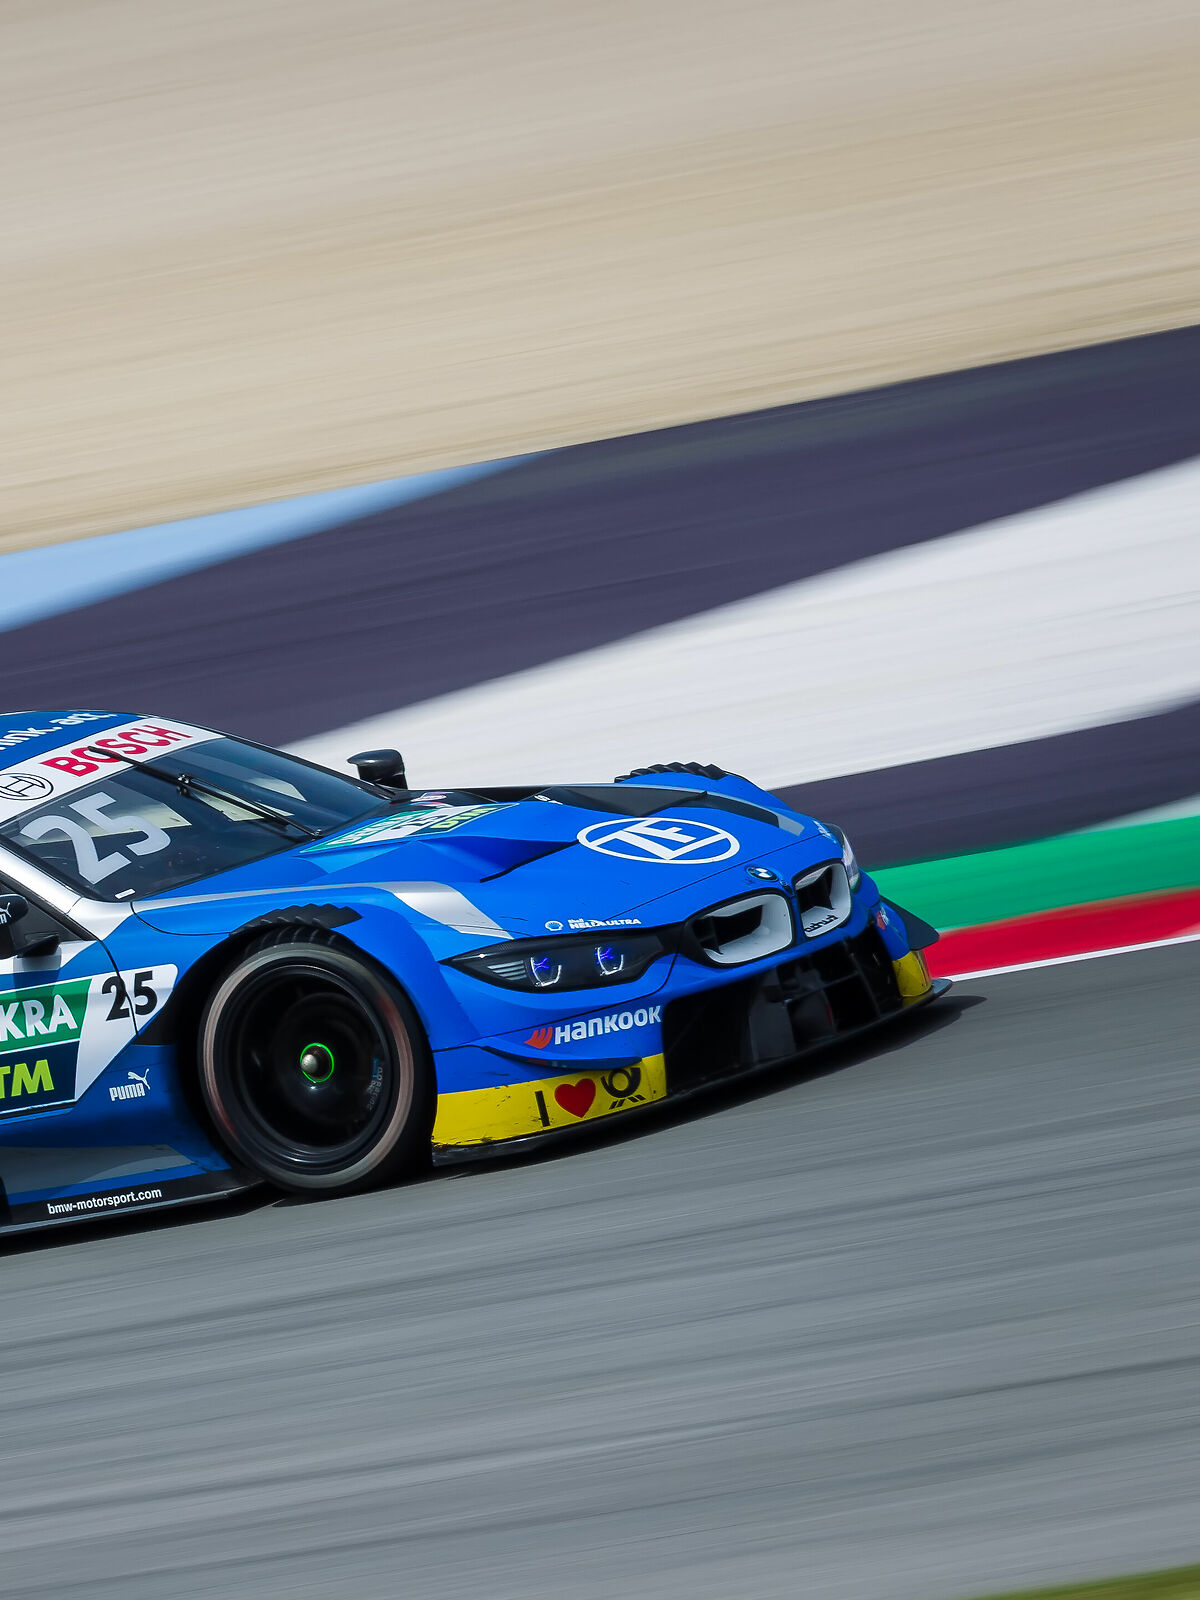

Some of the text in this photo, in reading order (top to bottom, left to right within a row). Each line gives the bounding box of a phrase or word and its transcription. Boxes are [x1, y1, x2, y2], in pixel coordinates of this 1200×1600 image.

[39, 724, 193, 777] BOSCH
[20, 791, 171, 885] 25
[584, 818, 730, 862] ZF
[101, 970, 158, 1022] 25
[109, 1083, 146, 1101] PUMA
[535, 1090, 551, 1128] I
[47, 1188, 163, 1214] bmw-motorsport.com
